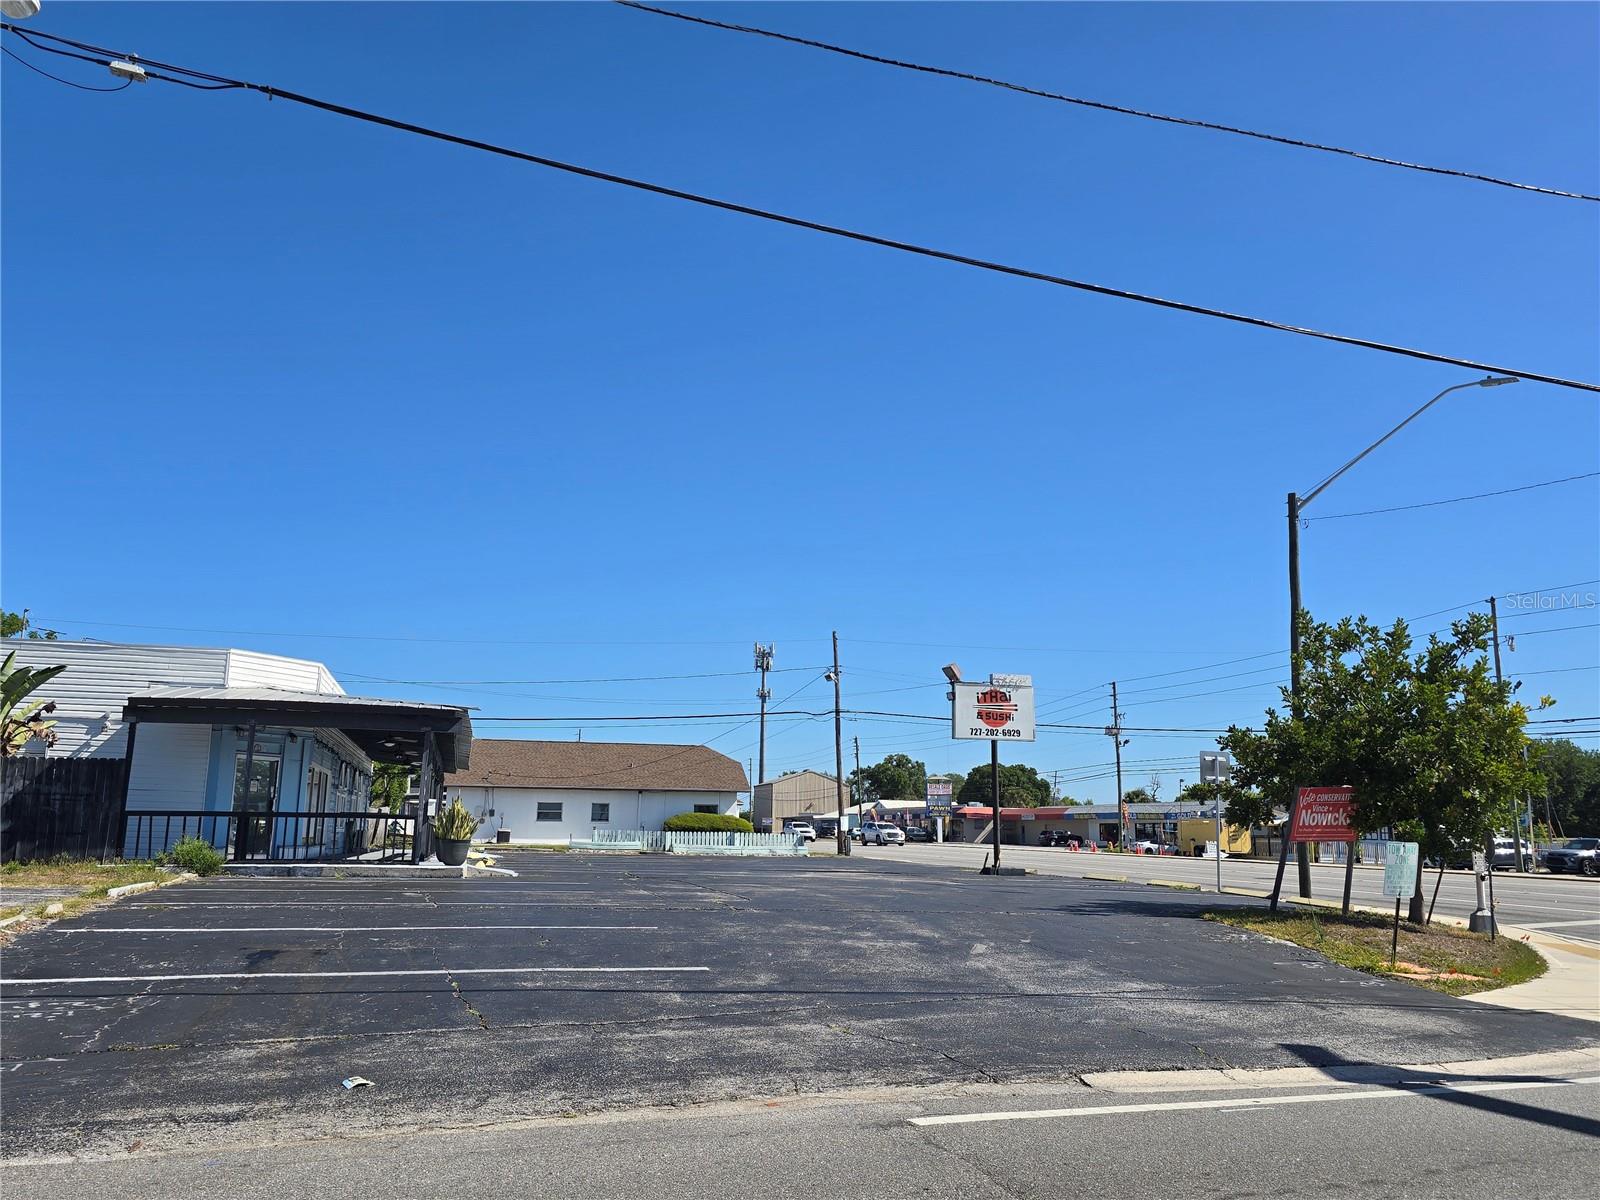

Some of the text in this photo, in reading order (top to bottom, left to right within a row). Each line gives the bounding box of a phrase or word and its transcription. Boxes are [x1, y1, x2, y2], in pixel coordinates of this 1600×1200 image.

[976, 712, 983, 720] &
[969, 727, 1021, 737] 727-202-6929
[1300, 788, 1316, 808] Vote
[1312, 804, 1329, 812] Vince
[1394, 855, 1409, 865] ZONE
